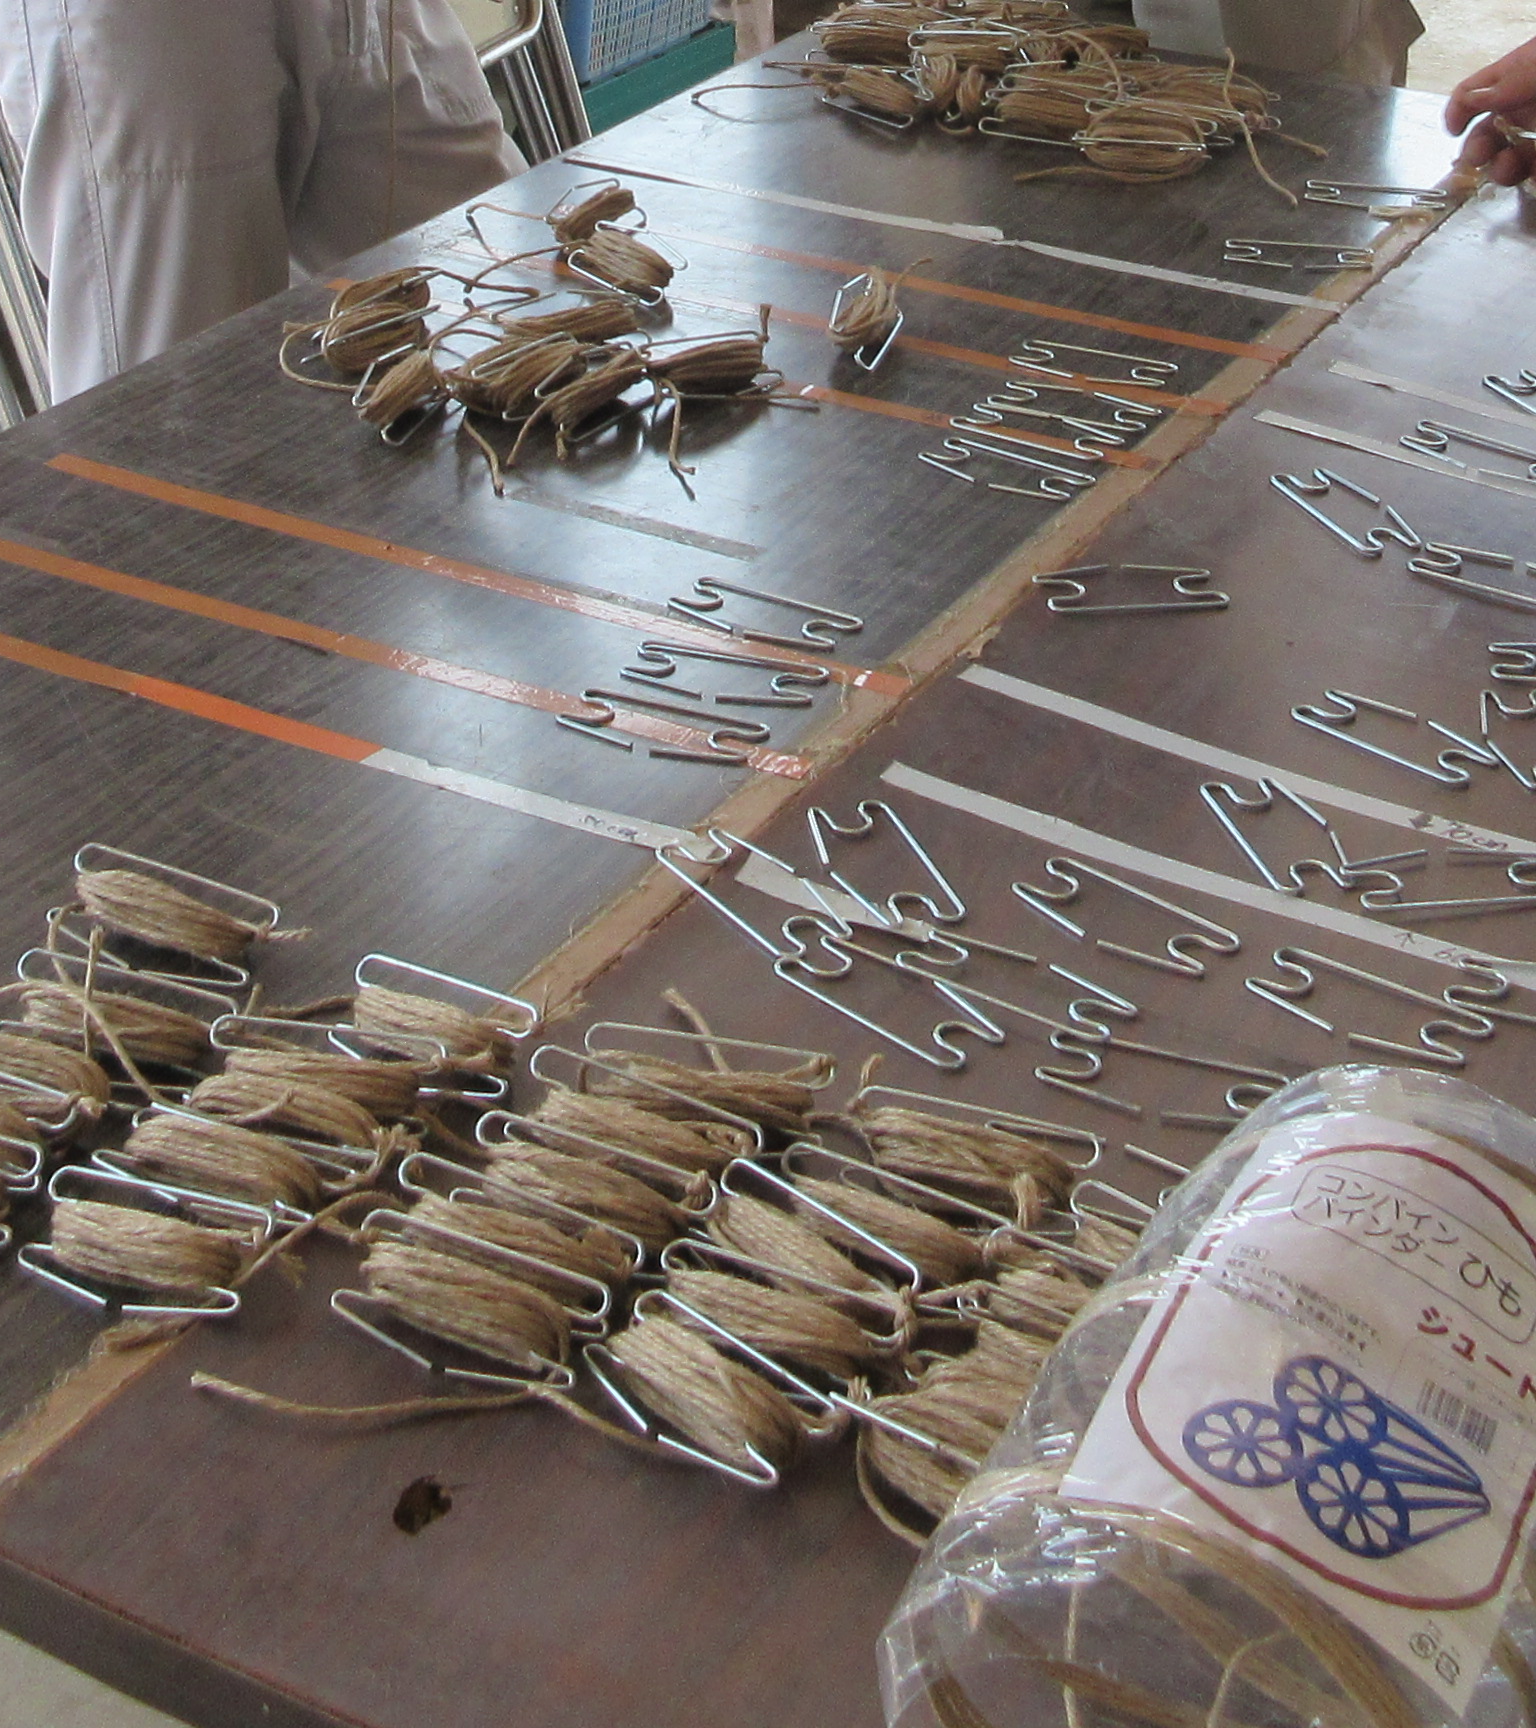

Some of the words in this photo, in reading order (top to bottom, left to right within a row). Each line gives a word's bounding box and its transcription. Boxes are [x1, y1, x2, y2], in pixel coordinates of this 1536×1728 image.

[1303, 1195, 1445, 1268] バインダー
[1317, 1175, 1459, 1245] コンバイン
[1458, 1252, 1522, 1317] ひも
